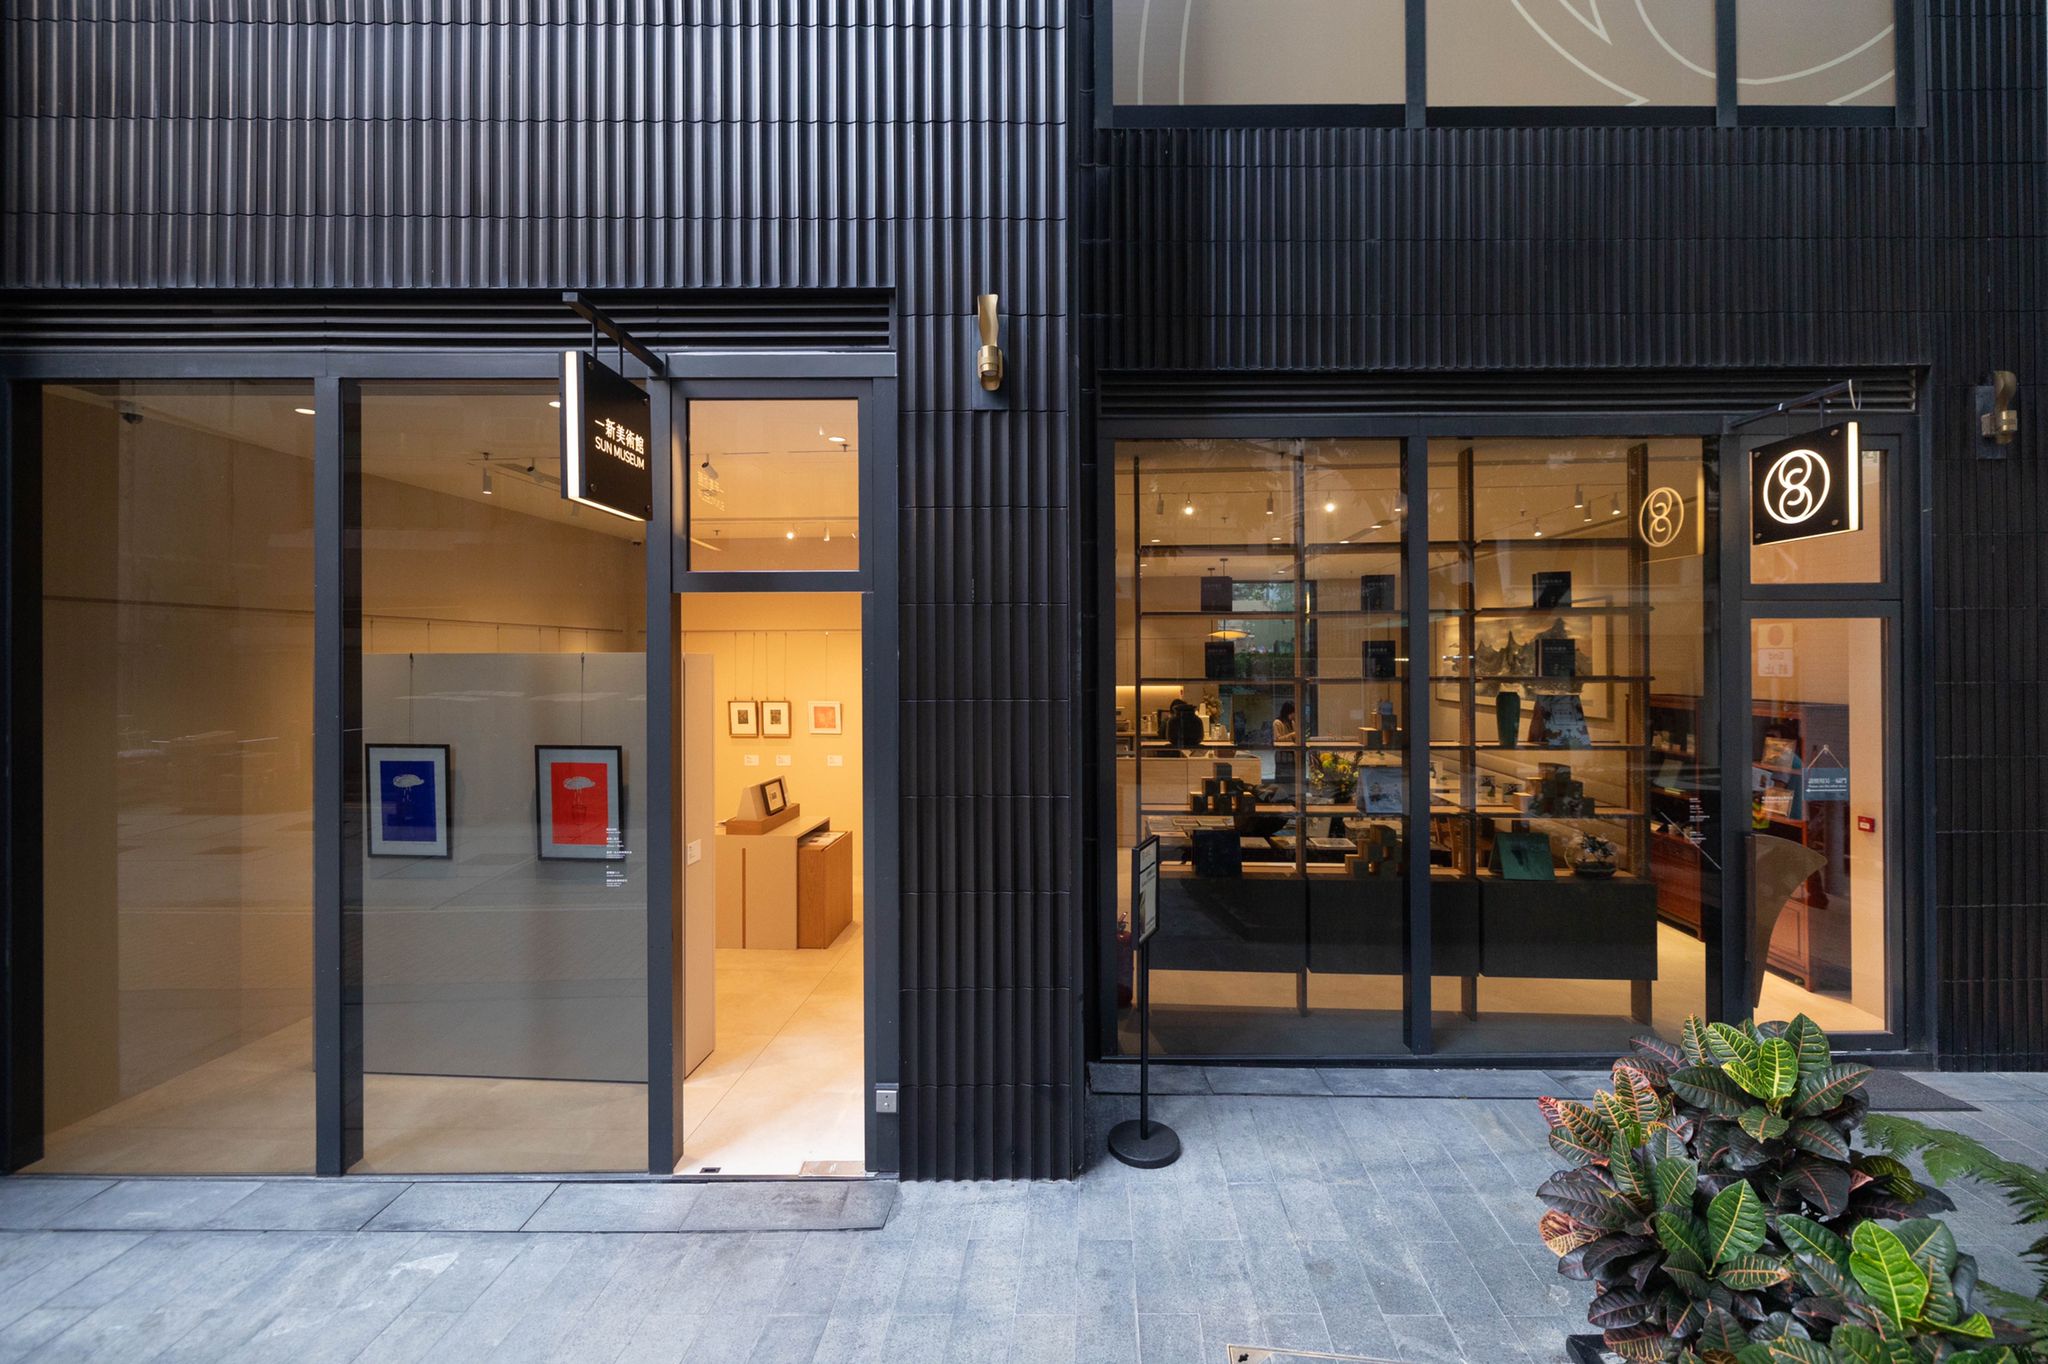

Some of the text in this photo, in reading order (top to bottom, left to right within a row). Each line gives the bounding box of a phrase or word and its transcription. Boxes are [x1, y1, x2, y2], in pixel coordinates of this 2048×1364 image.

[595, 418, 644, 455] 一新美術館
[595, 436, 645, 470] SUN MUSEUM
